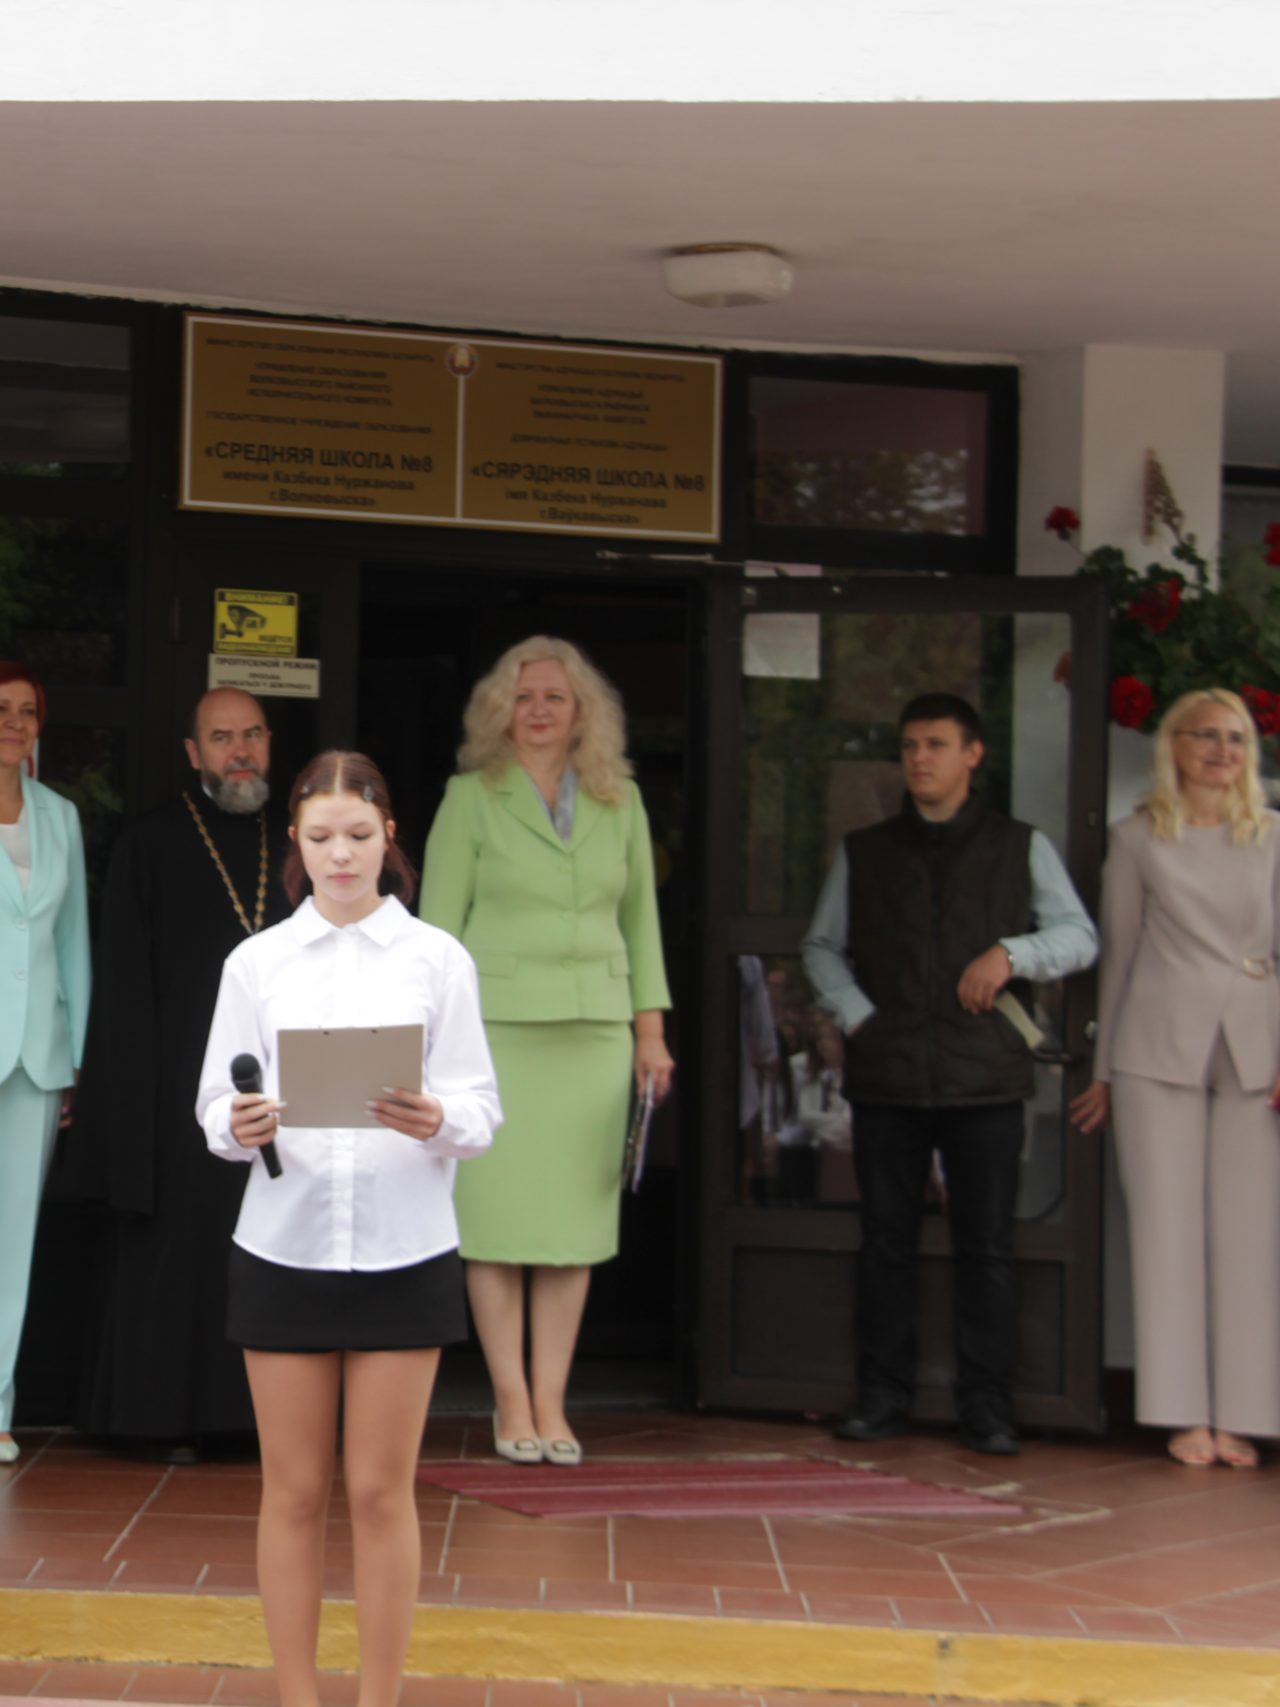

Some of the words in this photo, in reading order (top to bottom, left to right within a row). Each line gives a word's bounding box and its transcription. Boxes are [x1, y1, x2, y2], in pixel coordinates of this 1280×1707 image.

[204, 441, 314, 465] «СРЕДНЯЯ
[320, 448, 395, 471] ШКОЛА
[400, 454, 434, 473] №8
[471, 461, 591, 485] «СЯРЭДНЯЯ
[596, 468, 668, 490] ШКОЛА
[673, 473, 705, 492] №8
